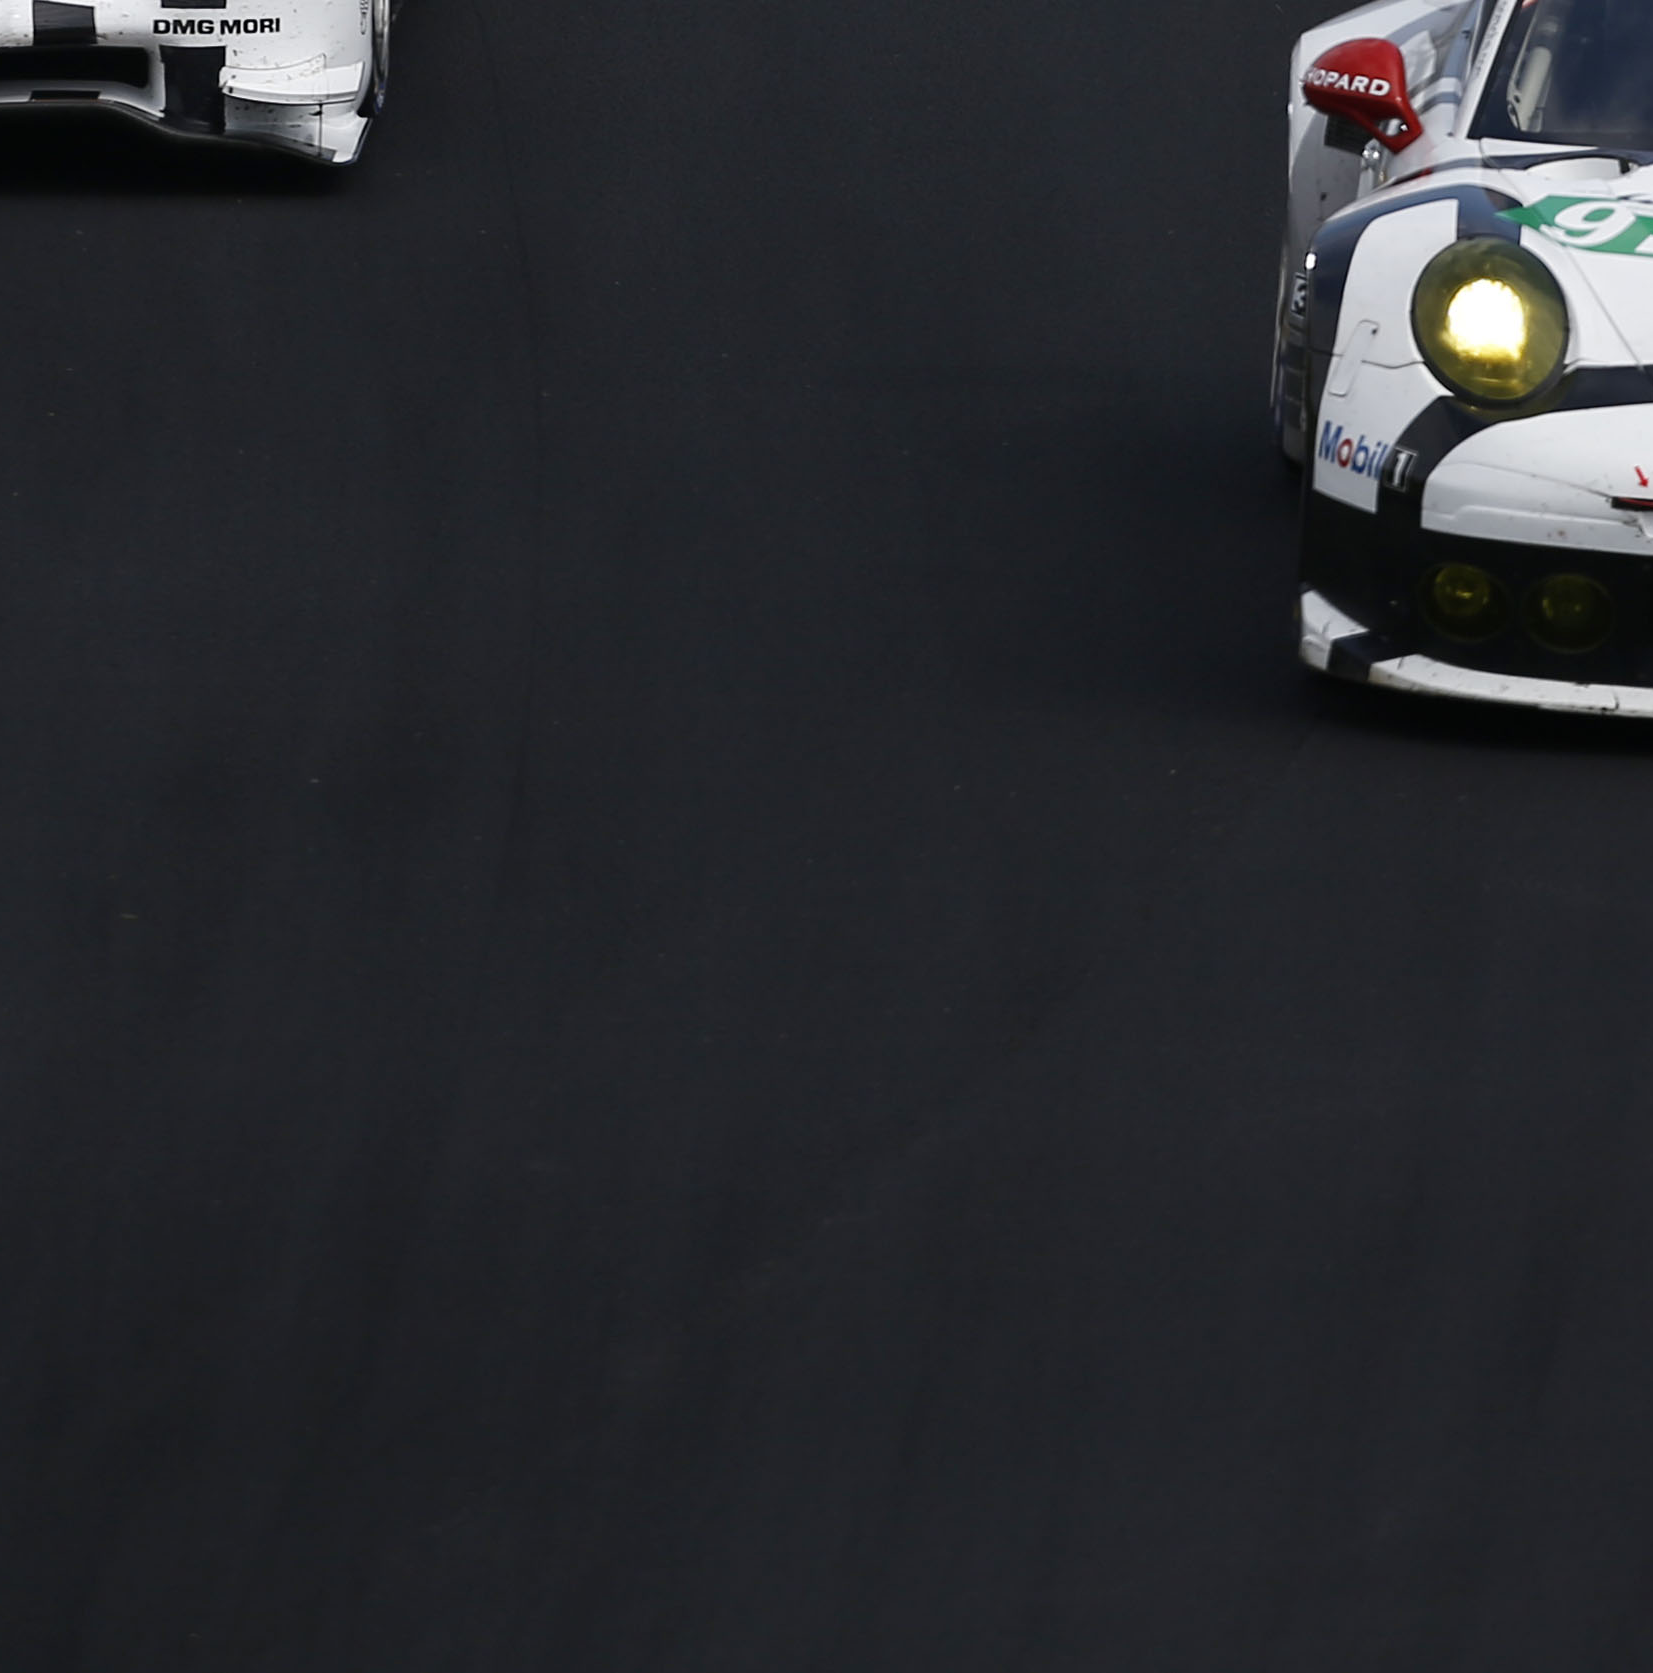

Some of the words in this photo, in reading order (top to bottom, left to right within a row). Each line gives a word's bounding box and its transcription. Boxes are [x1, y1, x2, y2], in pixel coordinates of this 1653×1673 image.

[152, 18, 215, 35] DMG
[219, 17, 281, 36] MORI
[1318, 419, 1389, 482] Mobil
